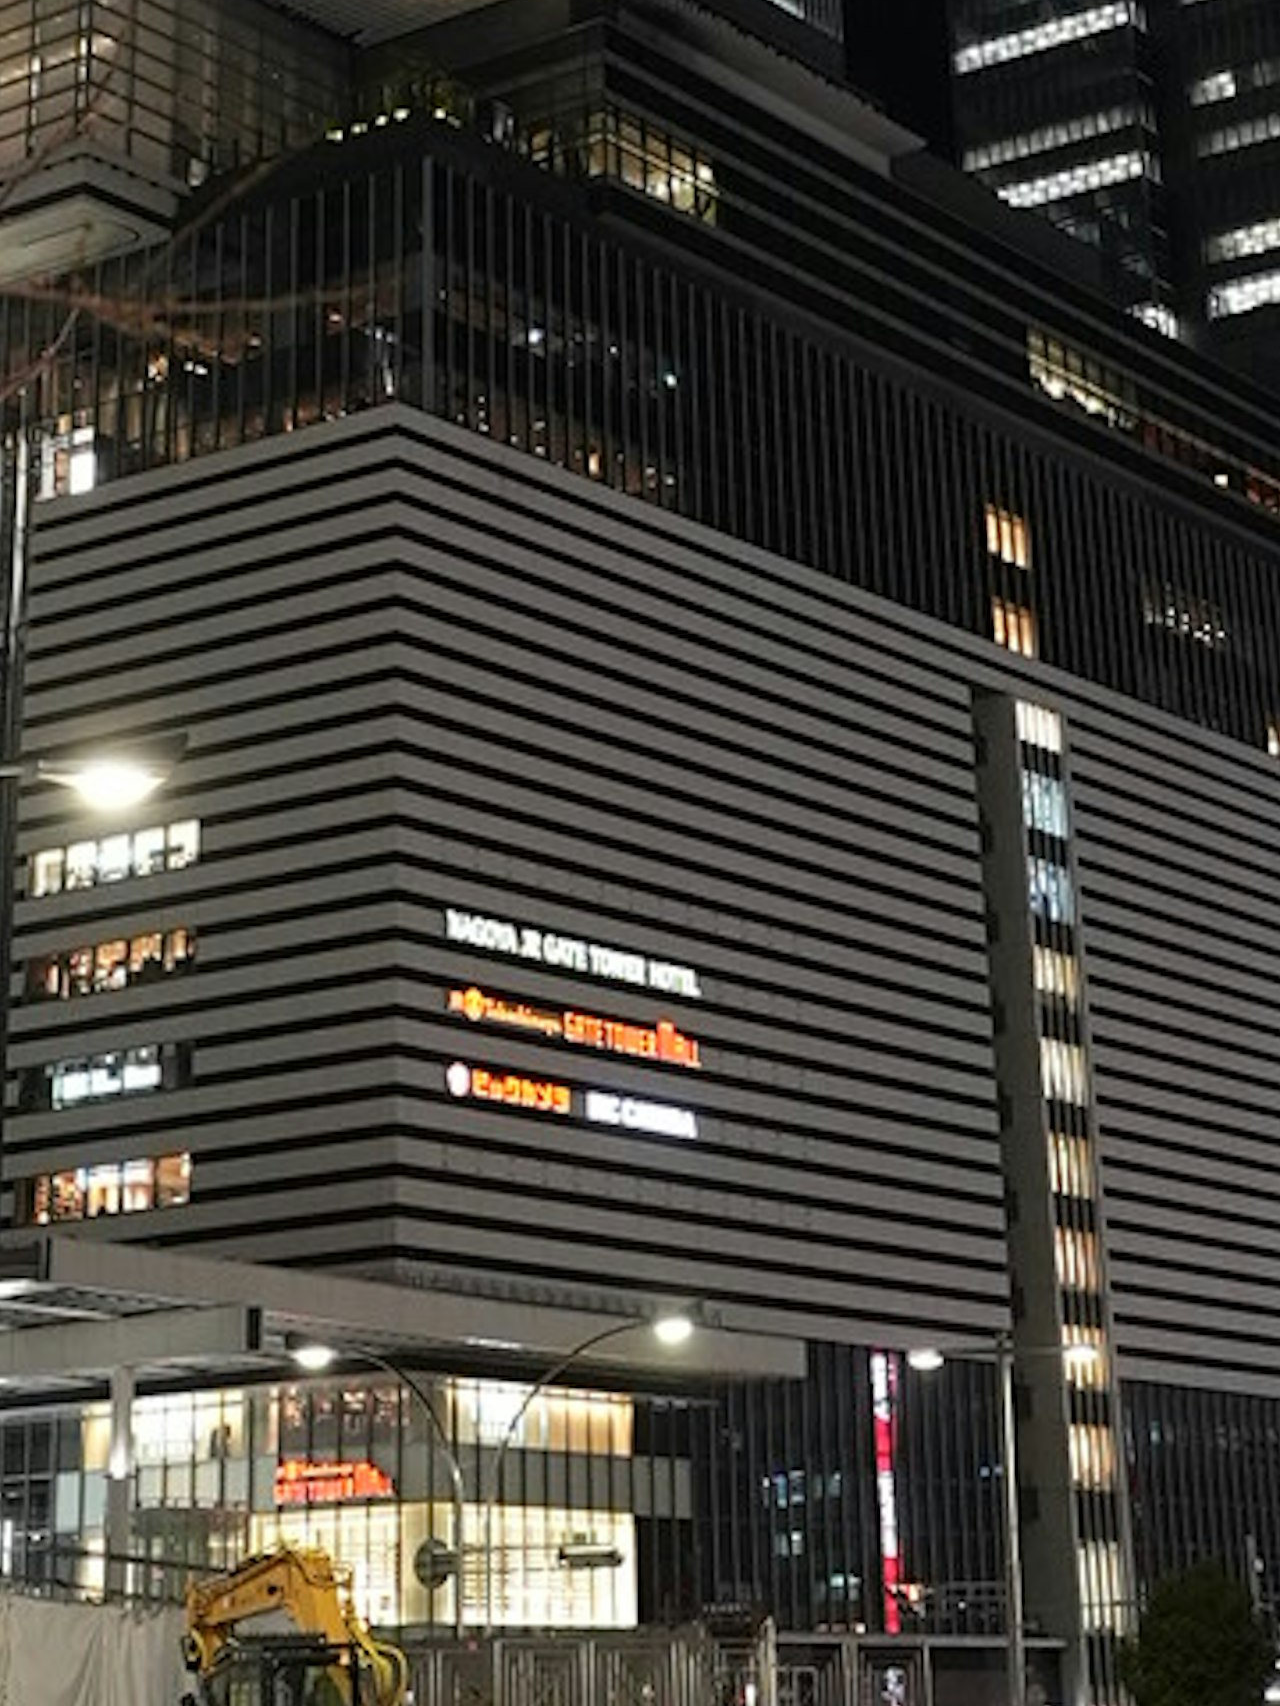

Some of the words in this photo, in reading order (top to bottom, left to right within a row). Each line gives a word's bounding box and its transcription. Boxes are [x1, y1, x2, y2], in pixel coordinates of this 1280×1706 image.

[446, 908, 517, 954] NAGOYA
[543, 933, 588, 972] GATE
[589, 944, 645, 986] TOWER
[649, 960, 701, 998] HOTEL
